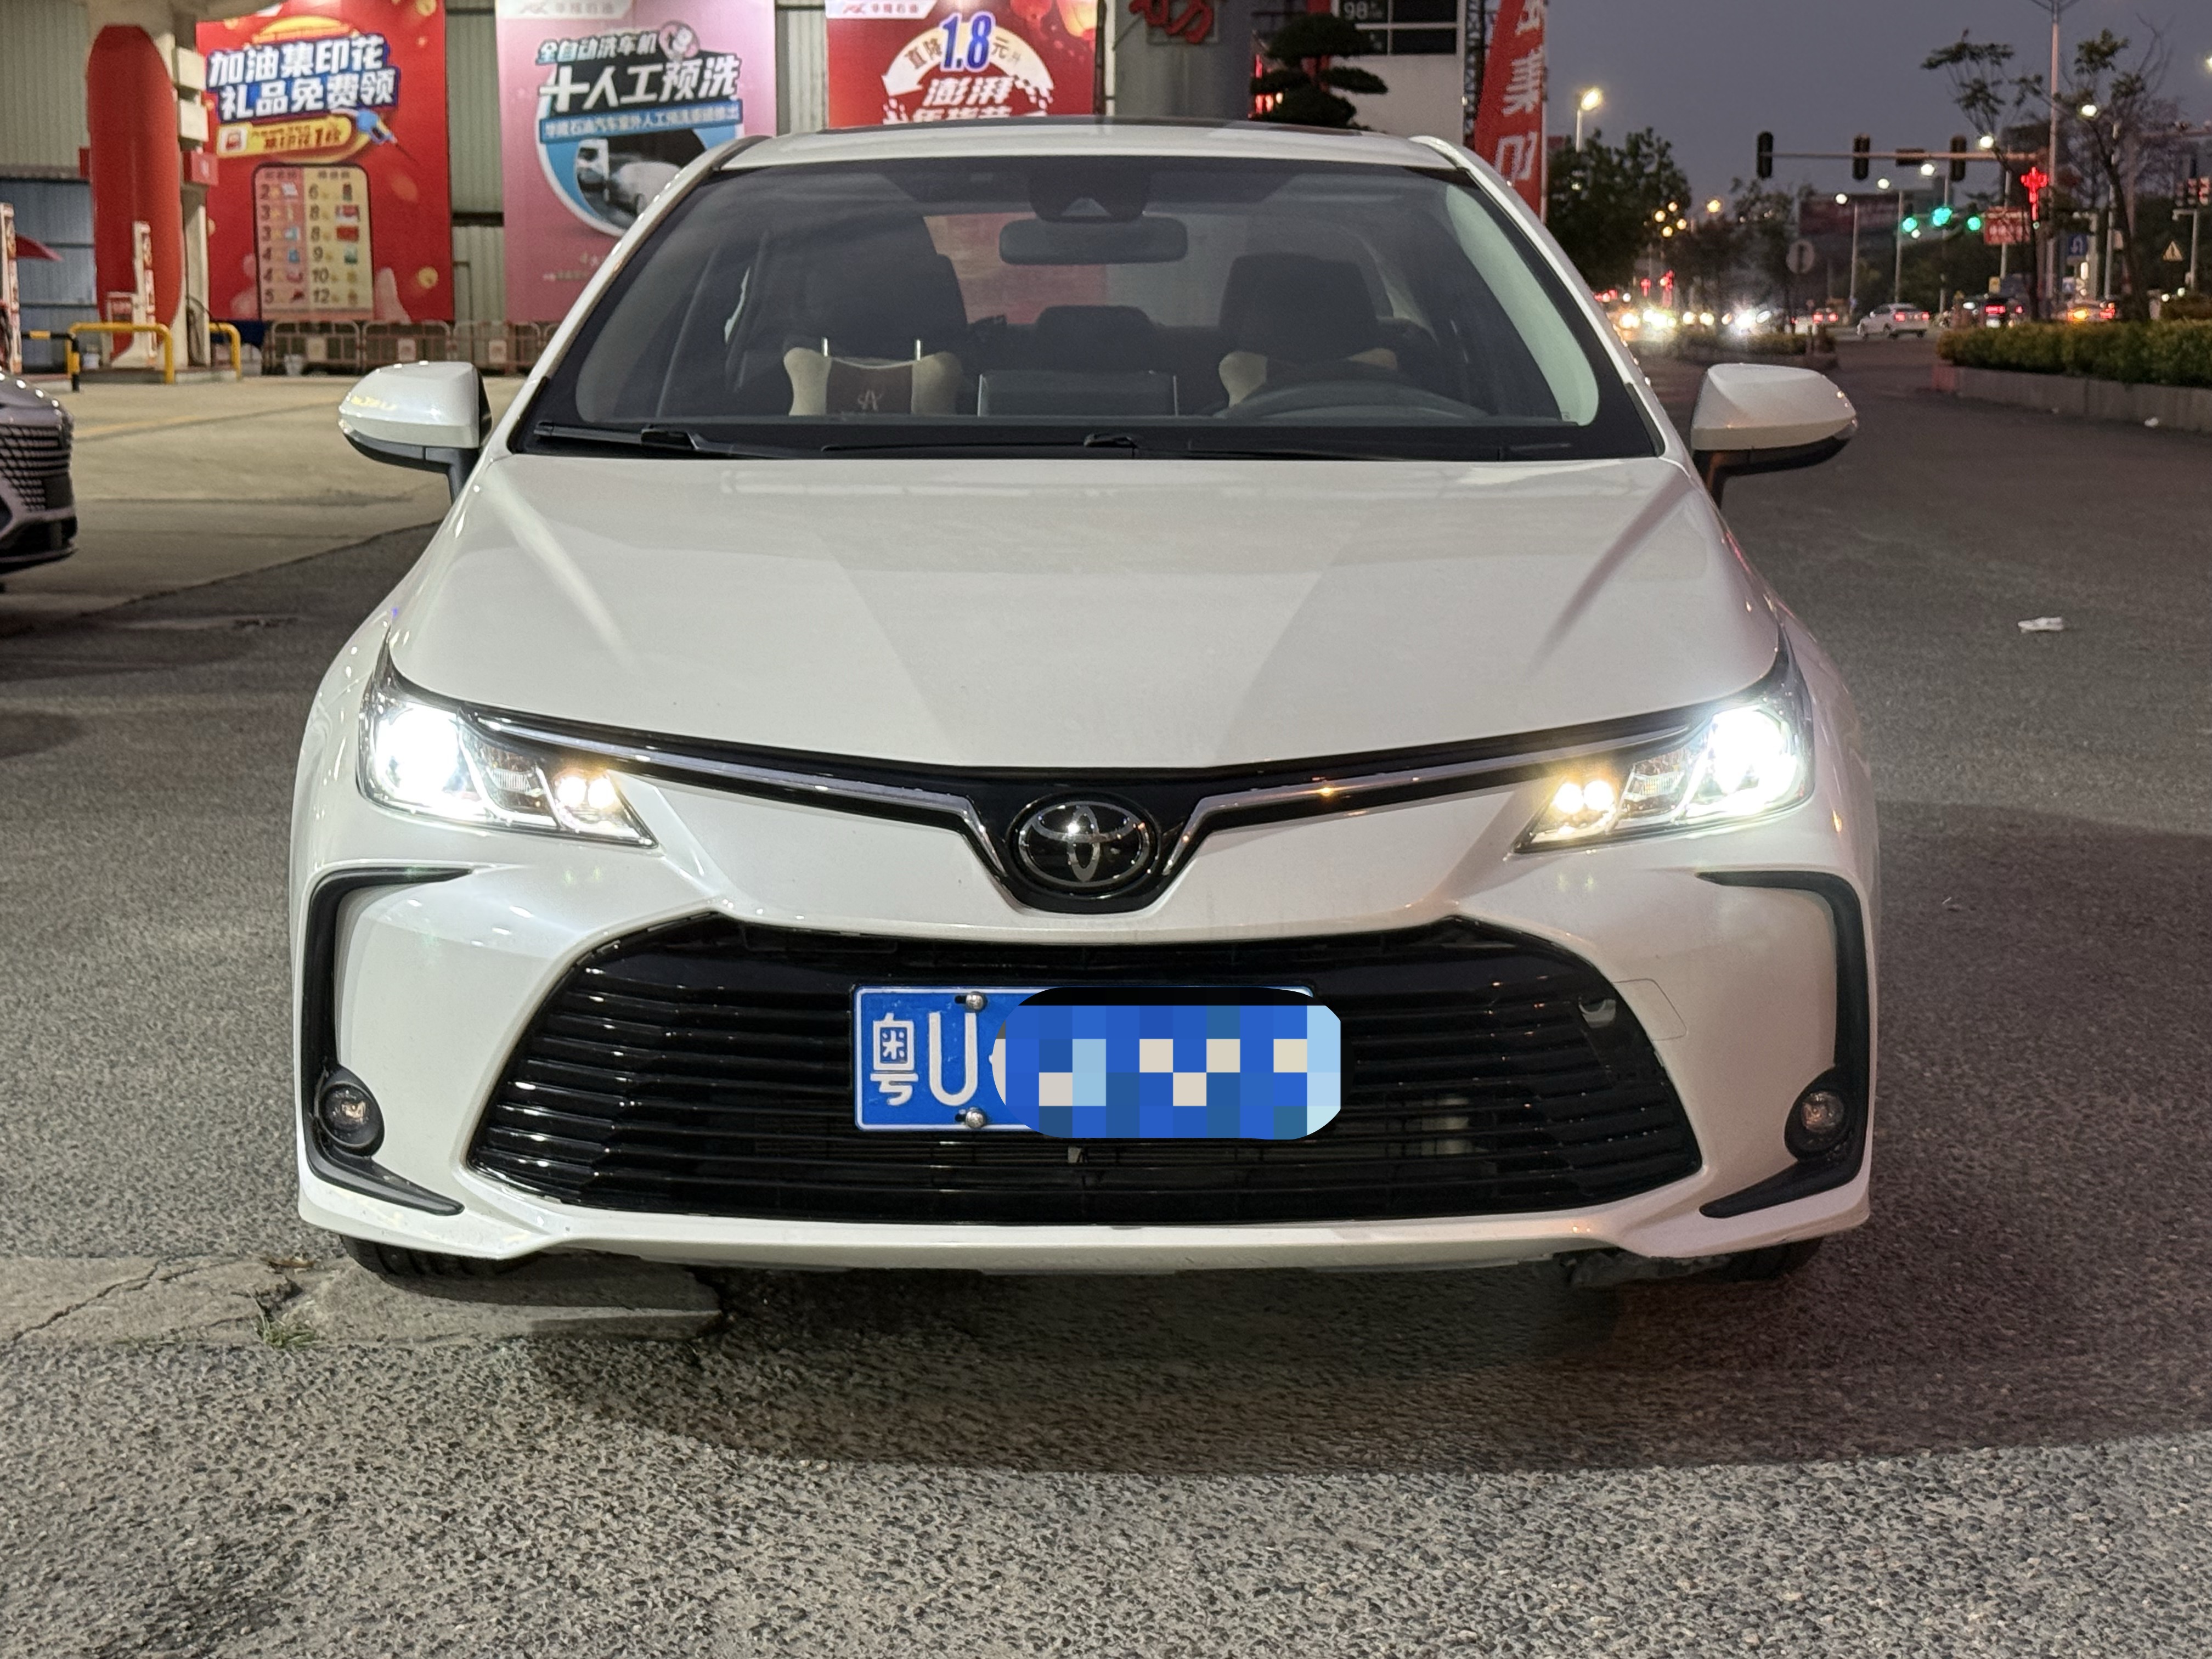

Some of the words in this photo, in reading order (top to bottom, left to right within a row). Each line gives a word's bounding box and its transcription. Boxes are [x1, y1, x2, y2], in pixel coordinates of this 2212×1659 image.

[1344, 1, 1368, 20] 98
[208, 35, 384, 87] 加油集印花
[538, 31, 657, 64] 全自动洗车机
[941, 14, 993, 70] 1.8
[221, 68, 396, 121] 礼品免费领
[922, 76, 1014, 106] 澎湃
[870, 1012, 978, 1107] 粤U
